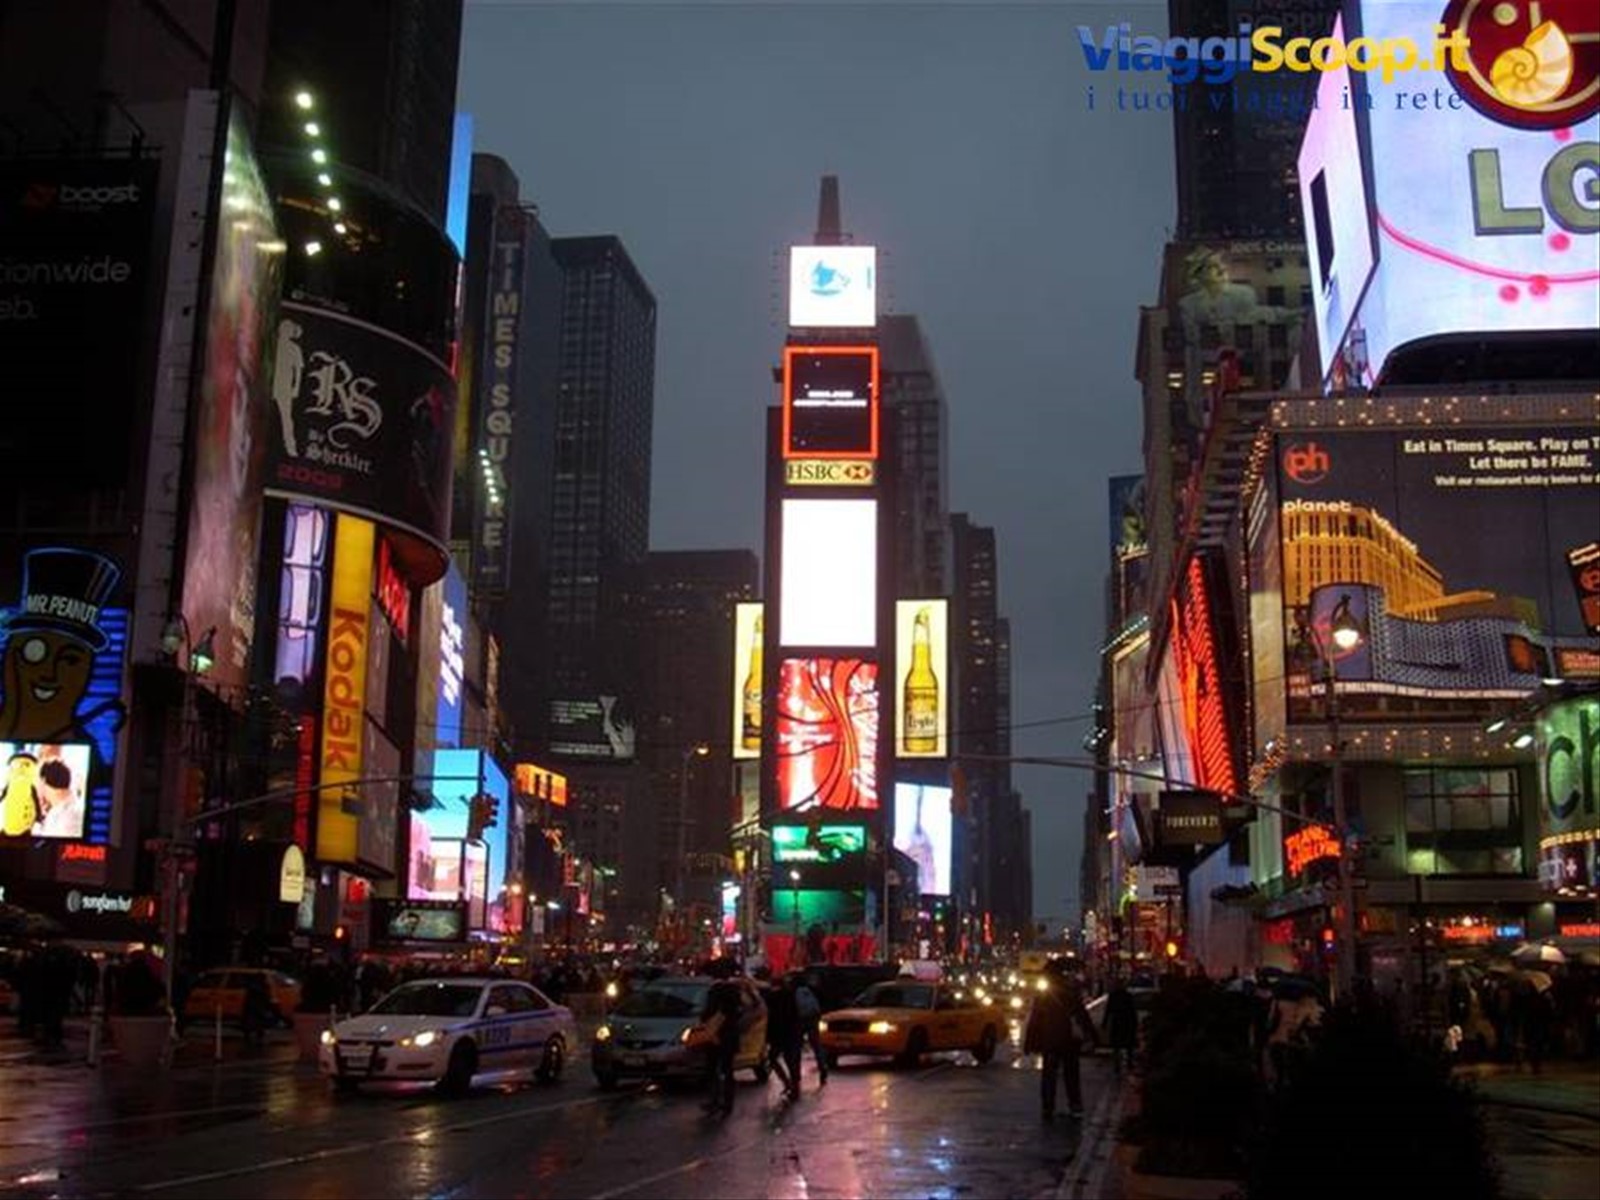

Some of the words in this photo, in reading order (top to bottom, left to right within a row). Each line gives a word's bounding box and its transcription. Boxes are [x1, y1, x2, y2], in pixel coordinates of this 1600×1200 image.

[59, 182, 141, 203] boost
[1467, 141, 1600, 236] LG
[493, 241, 521, 369] TIMES
[303, 351, 384, 448] RS
[1403, 440, 1426, 453] Eat
[1428, 439, 1442, 452] in
[1444, 439, 1485, 453] Times
[1486, 438, 1538, 455] Square.
[1539, 436, 1569, 453] Play
[1571, 439, 1589, 450] on
[786, 463, 843, 481] HSBC
[1468, 456, 1492, 470] Let
[1493, 455, 1529, 470] there
[1530, 455, 1548, 468] be
[1550, 454, 1593, 469] FAME.
[1282, 498, 1352, 514] planet
[48, 595, 99, 624] PEANUT
[323, 607, 367, 772] Kodak
